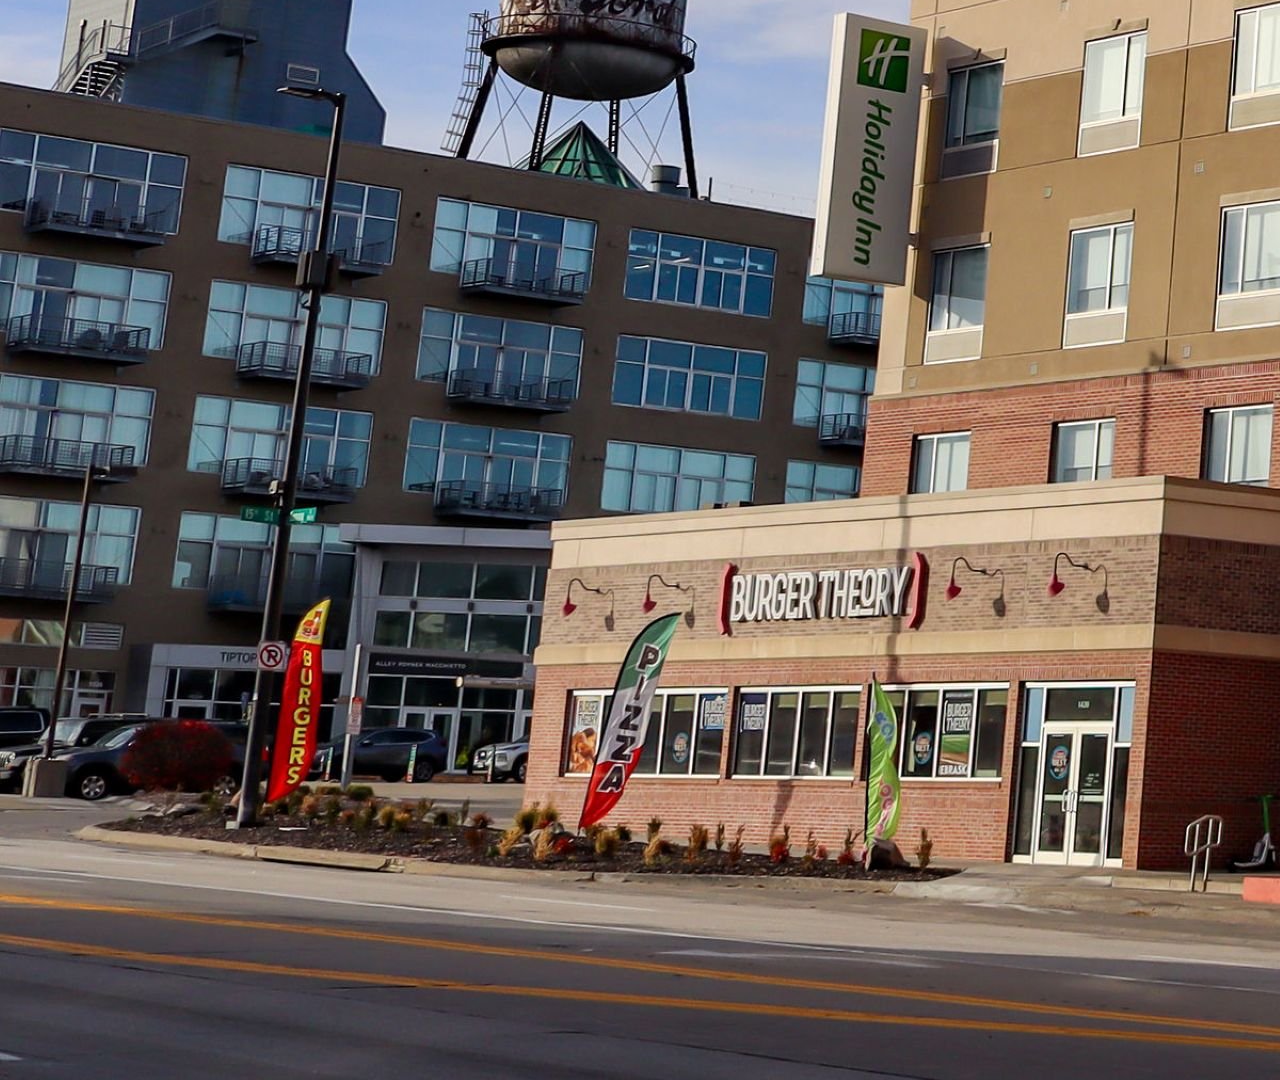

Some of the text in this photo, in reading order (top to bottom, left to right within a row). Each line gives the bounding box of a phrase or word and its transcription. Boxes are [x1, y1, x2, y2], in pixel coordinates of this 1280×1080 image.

[851, 98, 893, 267] Holiday Inn
[730, 566, 911, 622] BURGER THEORY
[286, 648, 313, 785] BURGERS
[596, 642, 662, 793] PIZZA
[946, 703, 972, 717] BURGER
